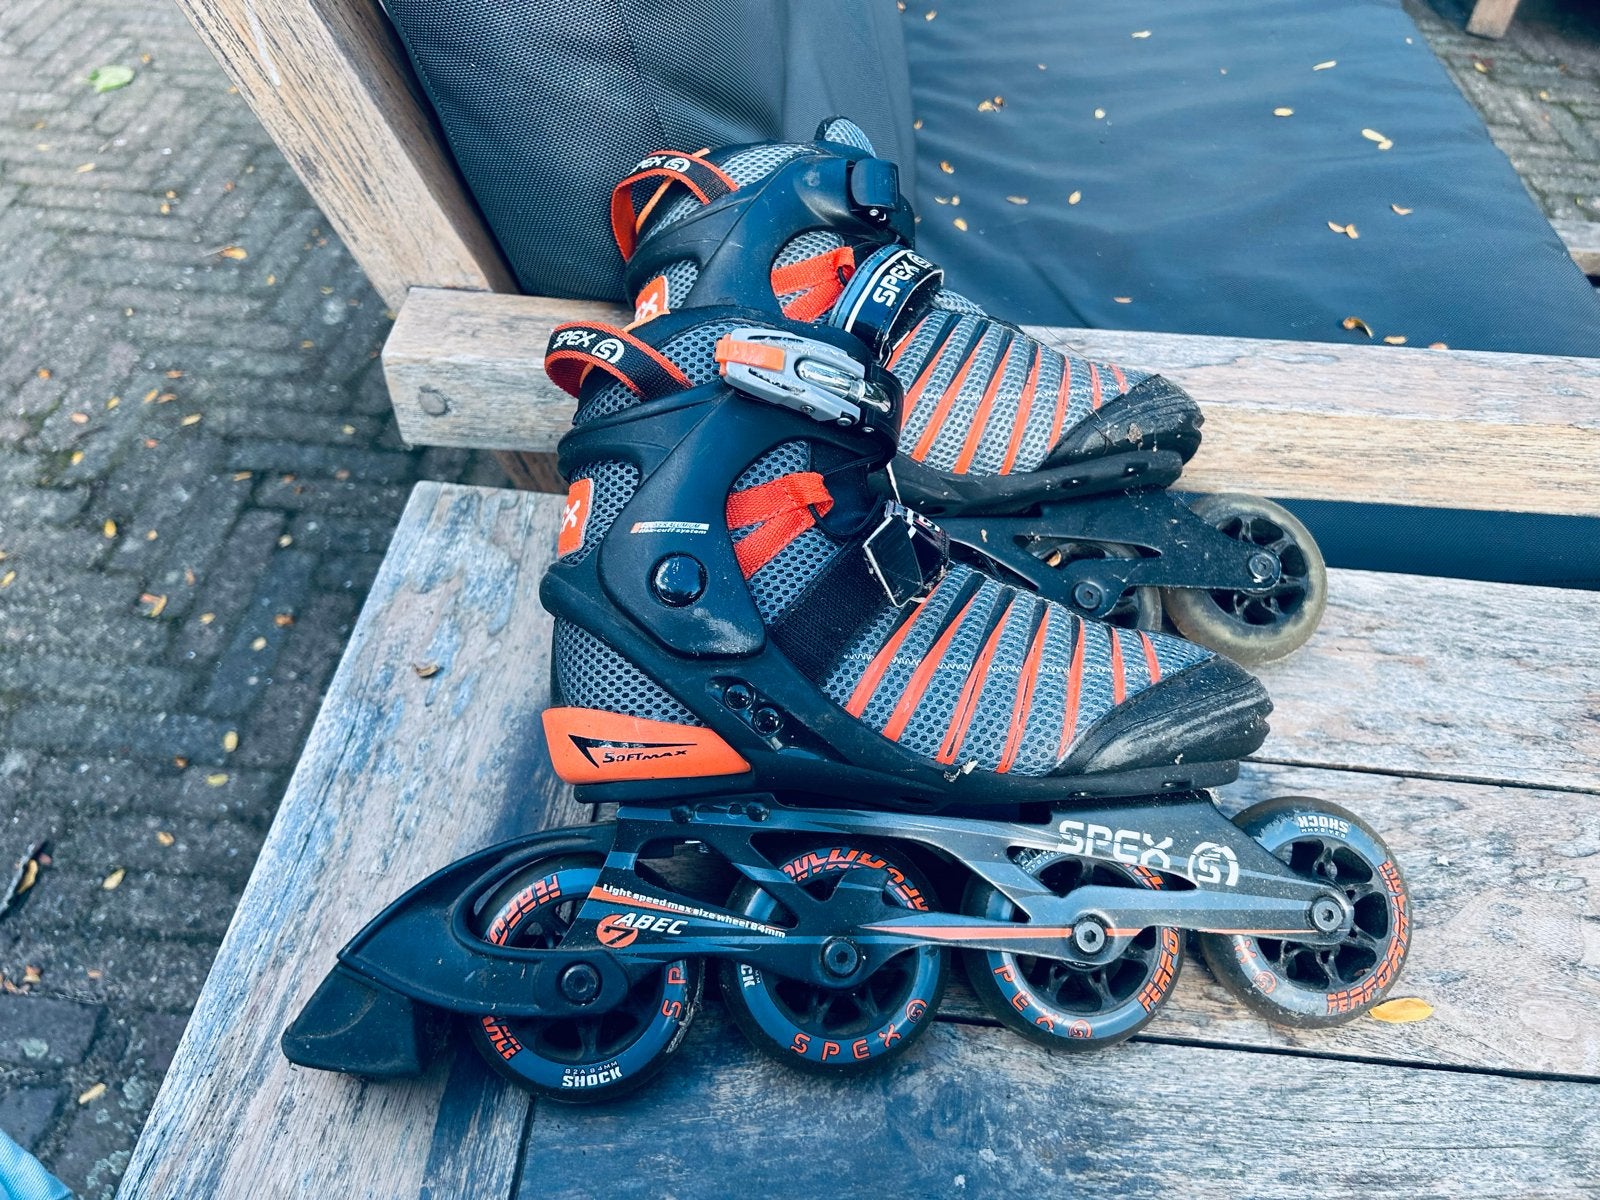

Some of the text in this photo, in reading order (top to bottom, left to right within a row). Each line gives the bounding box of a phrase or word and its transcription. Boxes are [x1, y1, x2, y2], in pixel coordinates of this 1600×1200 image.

[873, 260, 919, 307] SPEX
[553, 330, 597, 349] SPEX
[1297, 815, 1349, 833] SHOCK
[1056, 820, 1174, 869] SPEX
[613, 912, 688, 935] ABEC
[633, 892, 667, 907] speed
[667, 900, 693, 914] max
[692, 907, 717, 920] size
[716, 913, 751, 928] wheel
[603, 925, 635, 945] 7
[1326, 860, 1409, 1015] PERFORMANCE
[661, 966, 686, 1018] SP
[993, 964, 1054, 1033] PEX
[790, 1023, 901, 1061] SPEX
[562, 1066, 623, 1087] SHOCK
